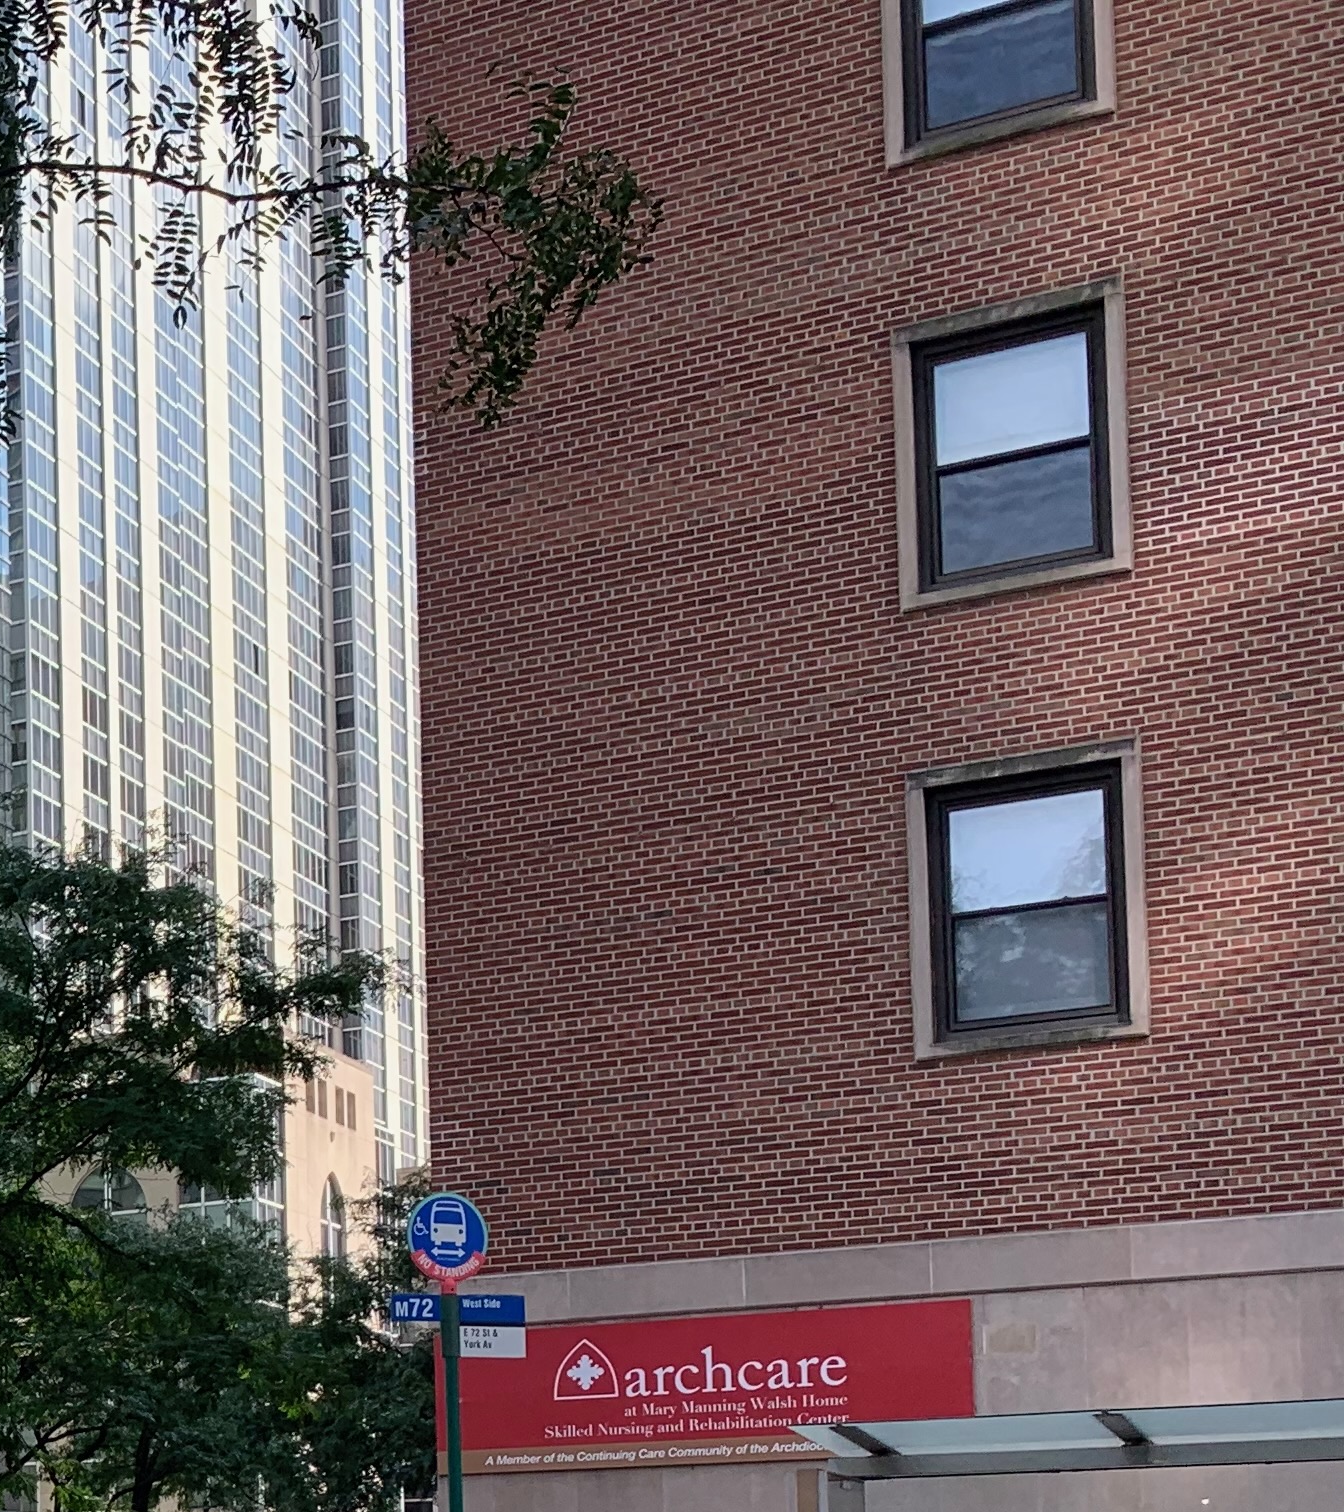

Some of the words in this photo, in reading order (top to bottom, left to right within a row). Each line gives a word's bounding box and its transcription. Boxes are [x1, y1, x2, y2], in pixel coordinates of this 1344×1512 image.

[417, 1253, 432, 1269] NO
[433, 1256, 480, 1277] STANDING
[395, 1298, 434, 1317] M72
[462, 1299, 482, 1309] West
[483, 1299, 501, 1309] Side
[463, 1339, 481, 1349] York
[482, 1339, 492, 1349] Av
[471, 1328, 480, 1337] 72
[482, 1328, 490, 1337] St
[492, 1328, 498, 1337] &
[624, 1345, 848, 1398] archcare
[624, 1405, 637, 1417] at
[642, 1402, 675, 1419] Mary
[682, 1398, 746, 1415] Manning
[751, 1395, 797, 1411] Walsh
[802, 1394, 848, 1408] Home
[544, 1424, 593, 1439] Skilled
[596, 1421, 654, 1438] Nursing
[656, 1419, 684, 1434] and
[689, 1416, 792, 1432] Rehabilitation
[485, 1455, 494, 1466] A
[496, 1453, 541, 1466] Member
[543, 1452, 555, 1463] of
[557, 1451, 574, 1462] the
[577, 1449, 636, 1462] Continuing
[638, 1448, 665, 1459] Care
[668, 1444, 734, 1460] Community
[736, 1443, 749, 1455] of
[750, 1442, 768, 1454] the
[770, 1440, 825, 1453] Archdioc
